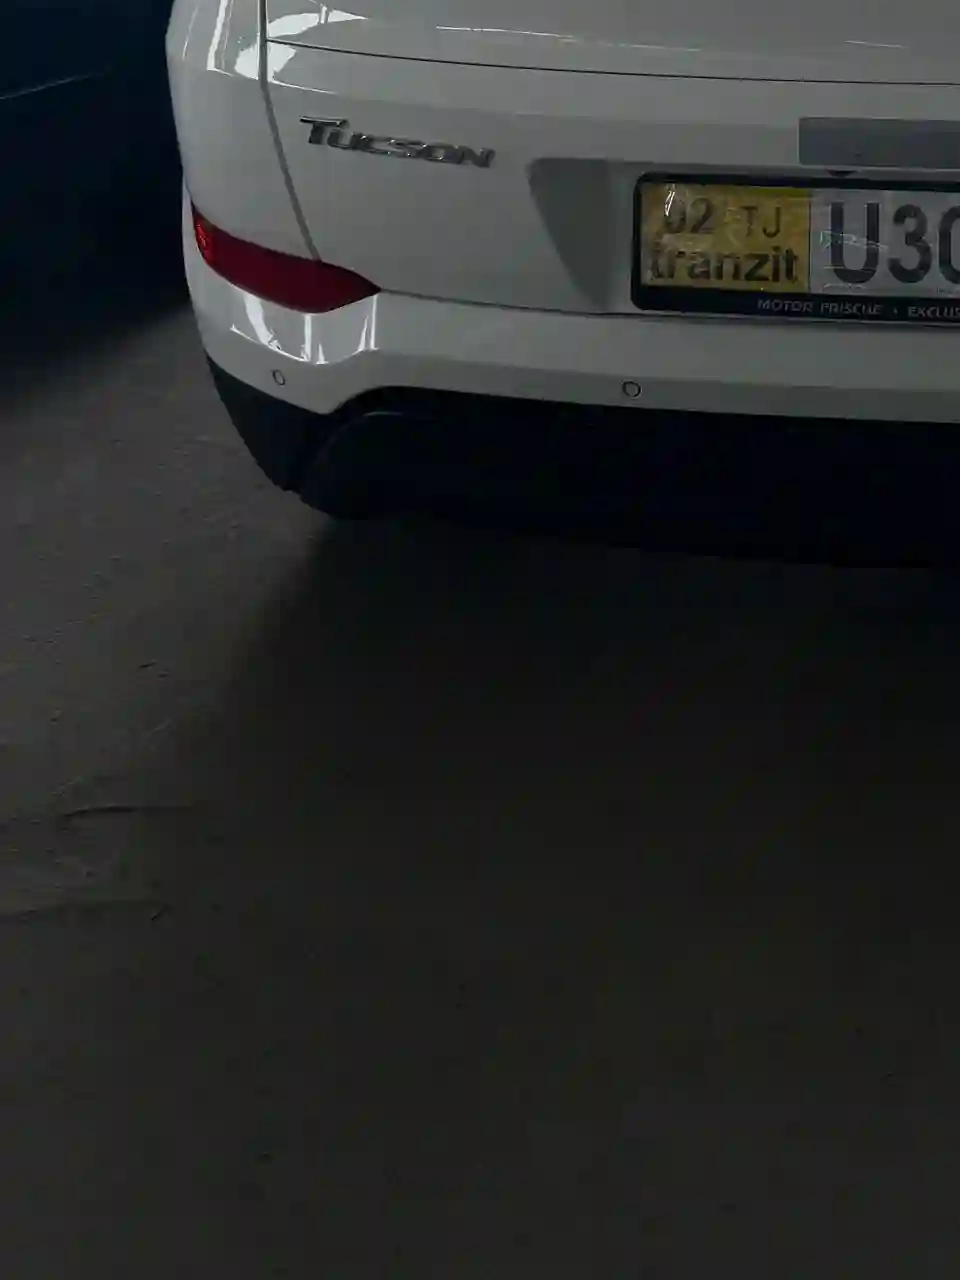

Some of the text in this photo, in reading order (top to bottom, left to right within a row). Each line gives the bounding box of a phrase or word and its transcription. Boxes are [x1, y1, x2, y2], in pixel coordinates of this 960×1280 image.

[740, 204, 783, 238] TJ
[650, 238, 799, 284] tranzit
[757, 298, 815, 314] MOTOR
